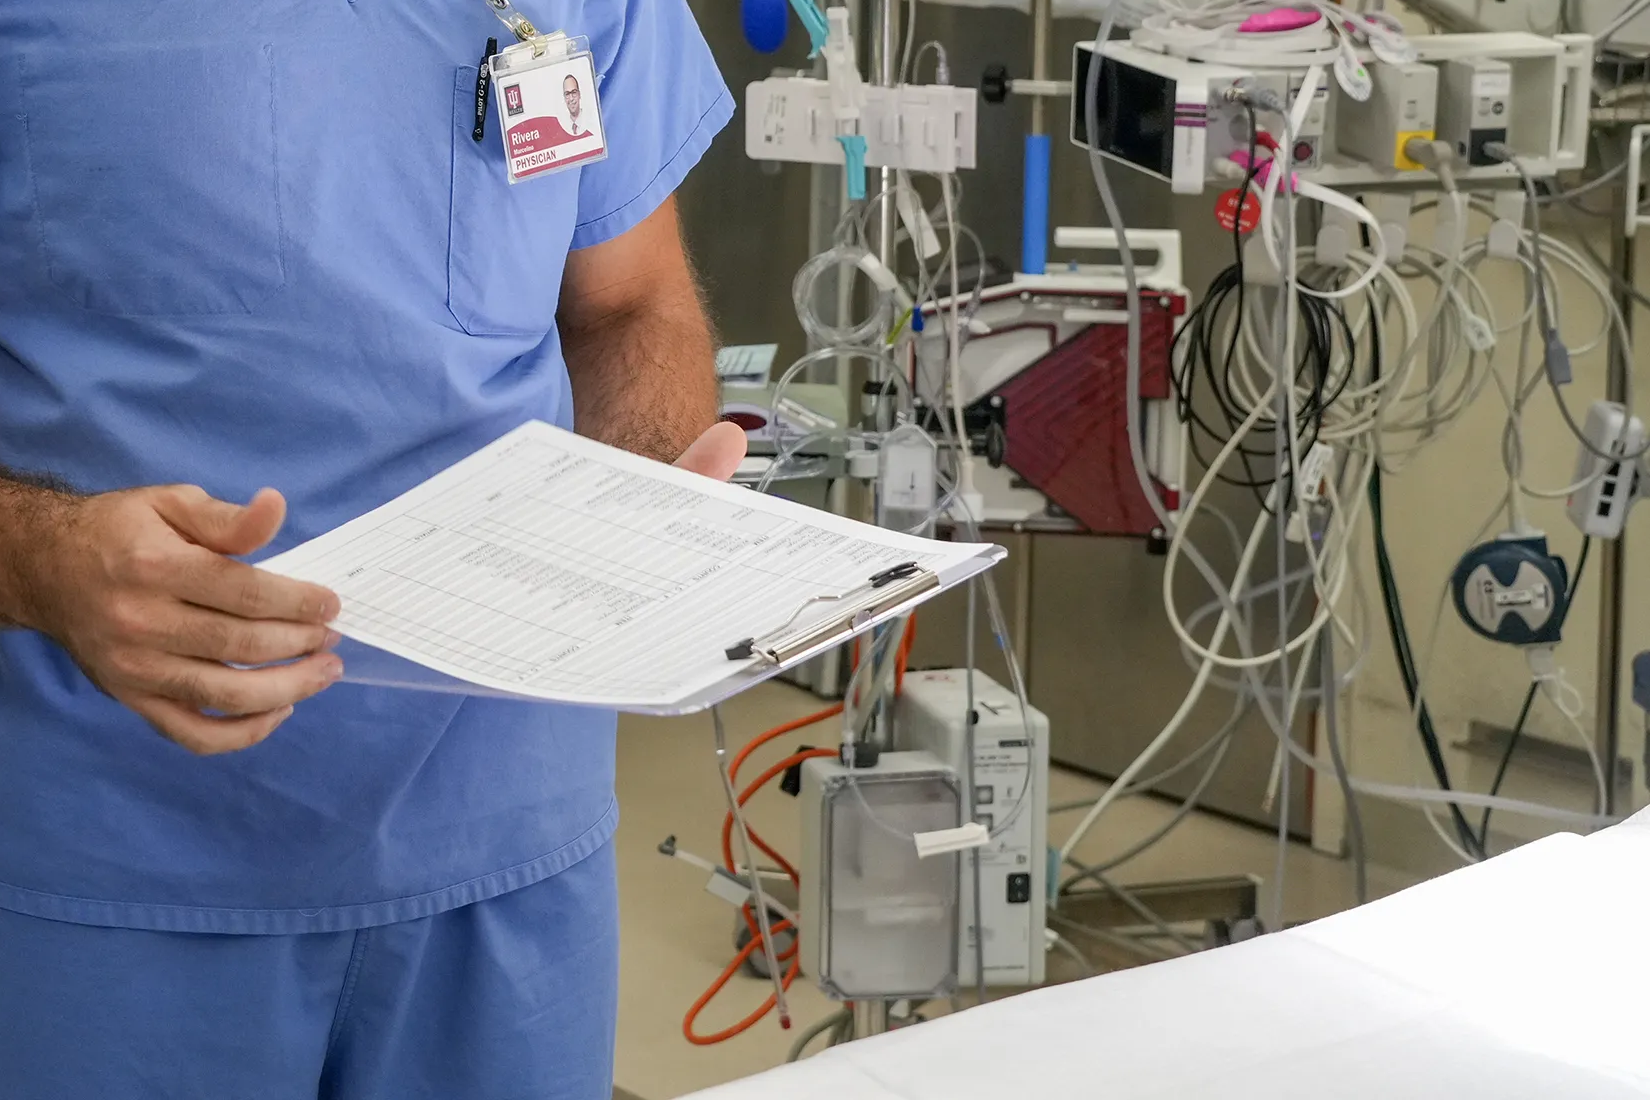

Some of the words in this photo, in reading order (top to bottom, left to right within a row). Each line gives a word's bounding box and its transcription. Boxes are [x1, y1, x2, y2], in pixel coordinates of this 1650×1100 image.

[477, 94, 485, 116] PILOT
[511, 129, 540, 146] Rivera
[516, 150, 557, 170] PHYSICIAN
